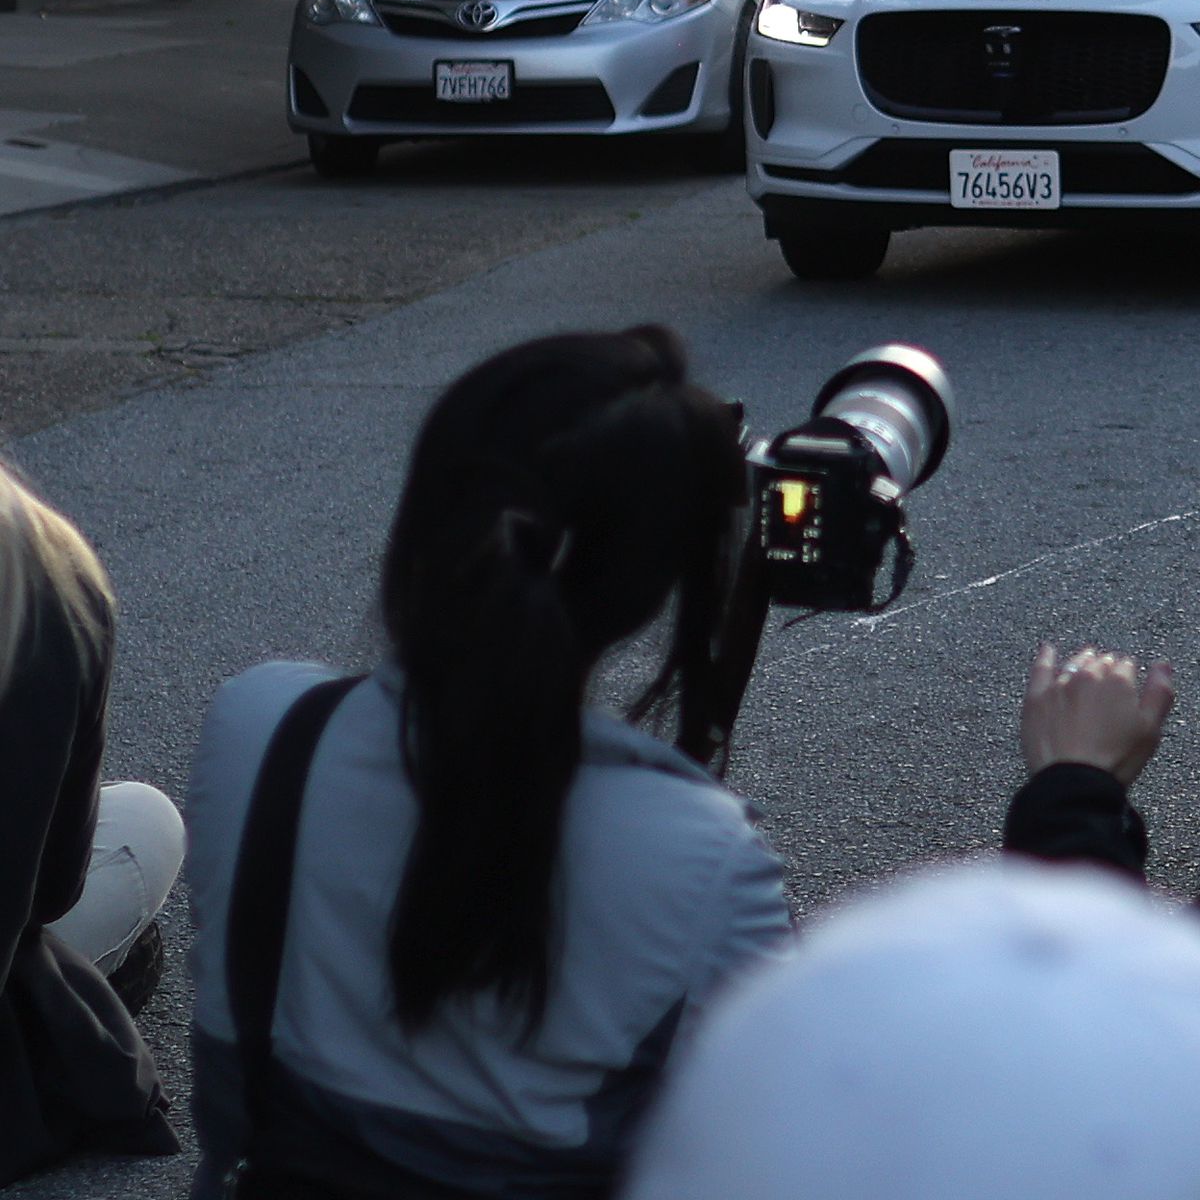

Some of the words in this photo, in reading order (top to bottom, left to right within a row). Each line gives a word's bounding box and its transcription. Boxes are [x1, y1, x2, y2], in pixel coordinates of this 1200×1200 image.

[439, 76, 506, 95] 7VFH766
[972, 155, 1031, 171] California
[958, 172, 1052, 199] 76456V3
